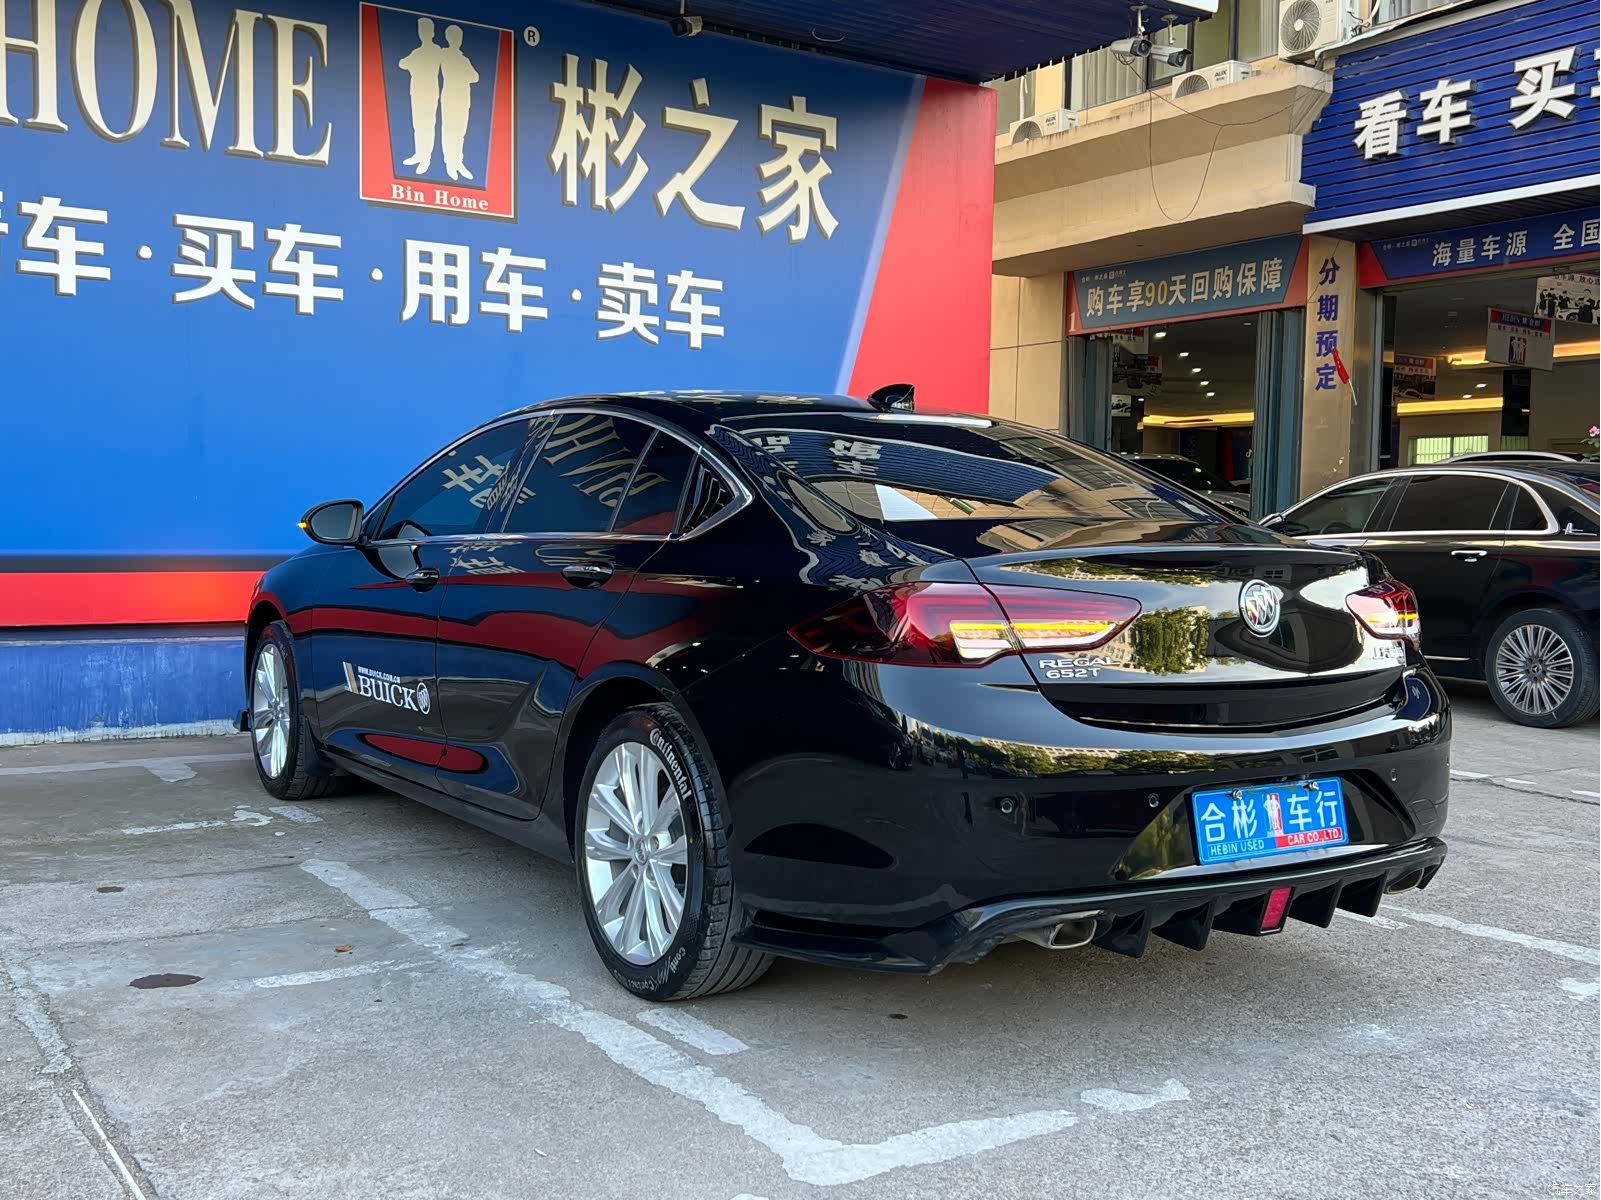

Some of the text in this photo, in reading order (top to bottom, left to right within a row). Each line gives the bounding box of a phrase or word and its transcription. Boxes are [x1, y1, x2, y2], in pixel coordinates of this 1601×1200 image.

[0, 0, 333, 167] HOME
[1352, 78, 1476, 161] 看车
[549, 52, 840, 245] 彬之家
[391, 183, 489, 211] Bin Home
[1432, 230, 1528, 268] 海量车源
[1086, 257, 1284, 318] 购车享90天回购保障
[1315, 256, 1341, 391] 分期预定
[1039, 656, 1121, 669] REGAL
[1046, 667, 1102, 679] 652T
[357, 674, 419, 712] BUICK
[649, 727, 692, 801] Continental
[1200, 790, 1338, 843] 合彬 车行
[1210, 842, 1238, 857] HEBIN
[1241, 839, 1265, 853] USED
[1287, 833, 1305, 846] CAR
